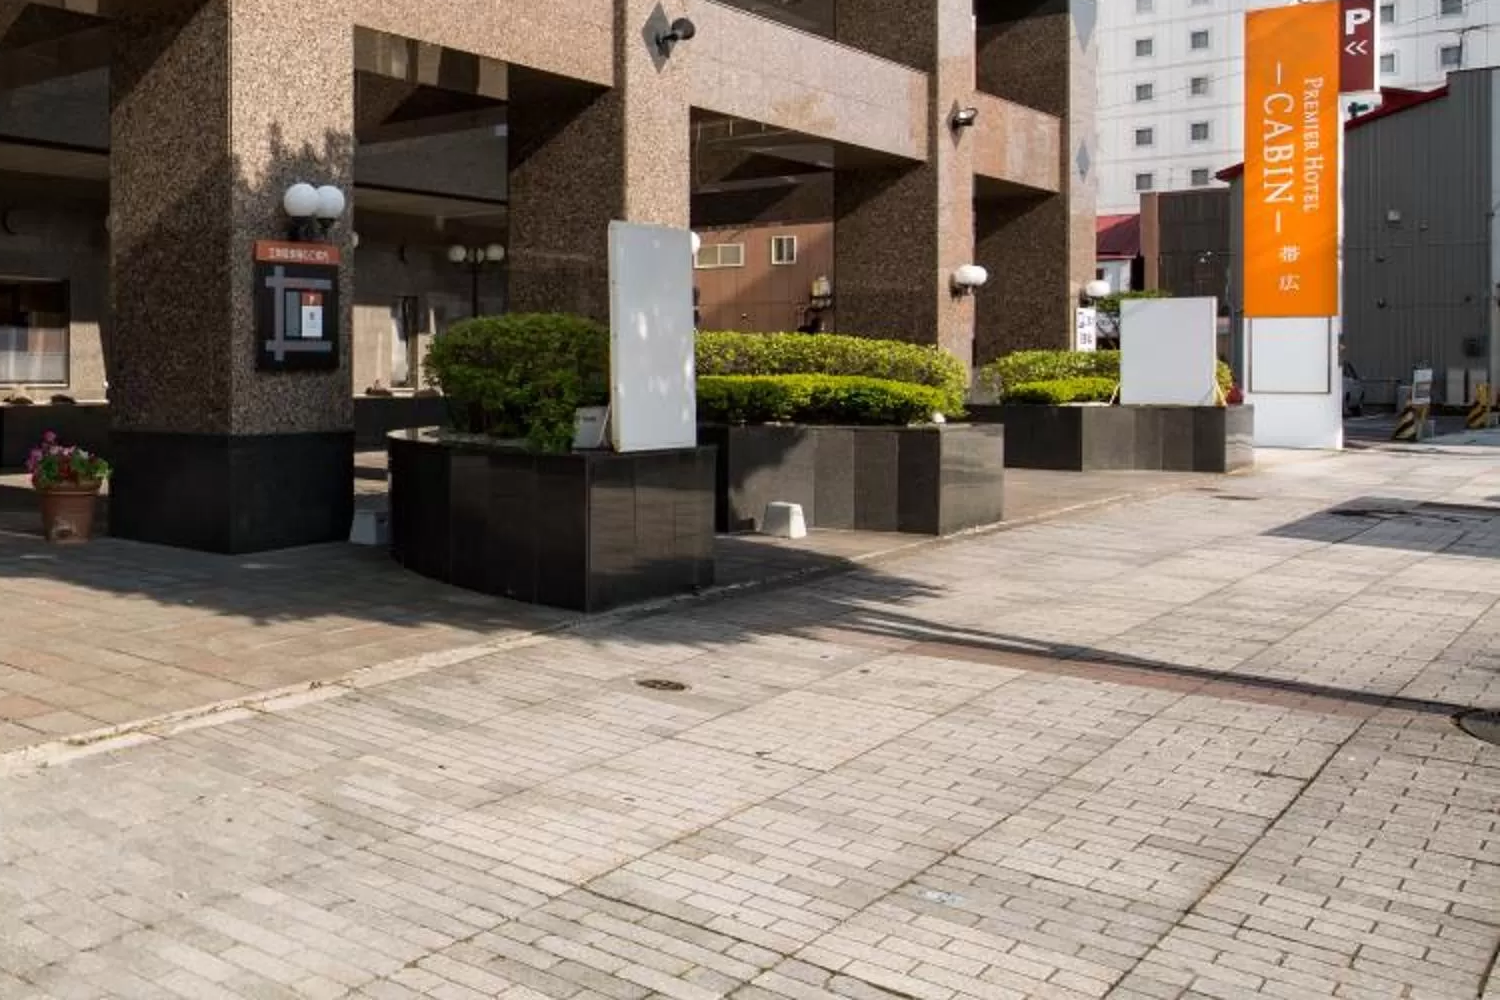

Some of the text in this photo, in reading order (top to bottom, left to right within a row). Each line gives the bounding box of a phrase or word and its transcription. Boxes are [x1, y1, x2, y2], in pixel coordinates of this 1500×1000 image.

[1344, 8, 1372, 36] P
[1263, 92, 1295, 204] CABIN
[1303, 76, 1325, 212] PREMIER HOTEL
